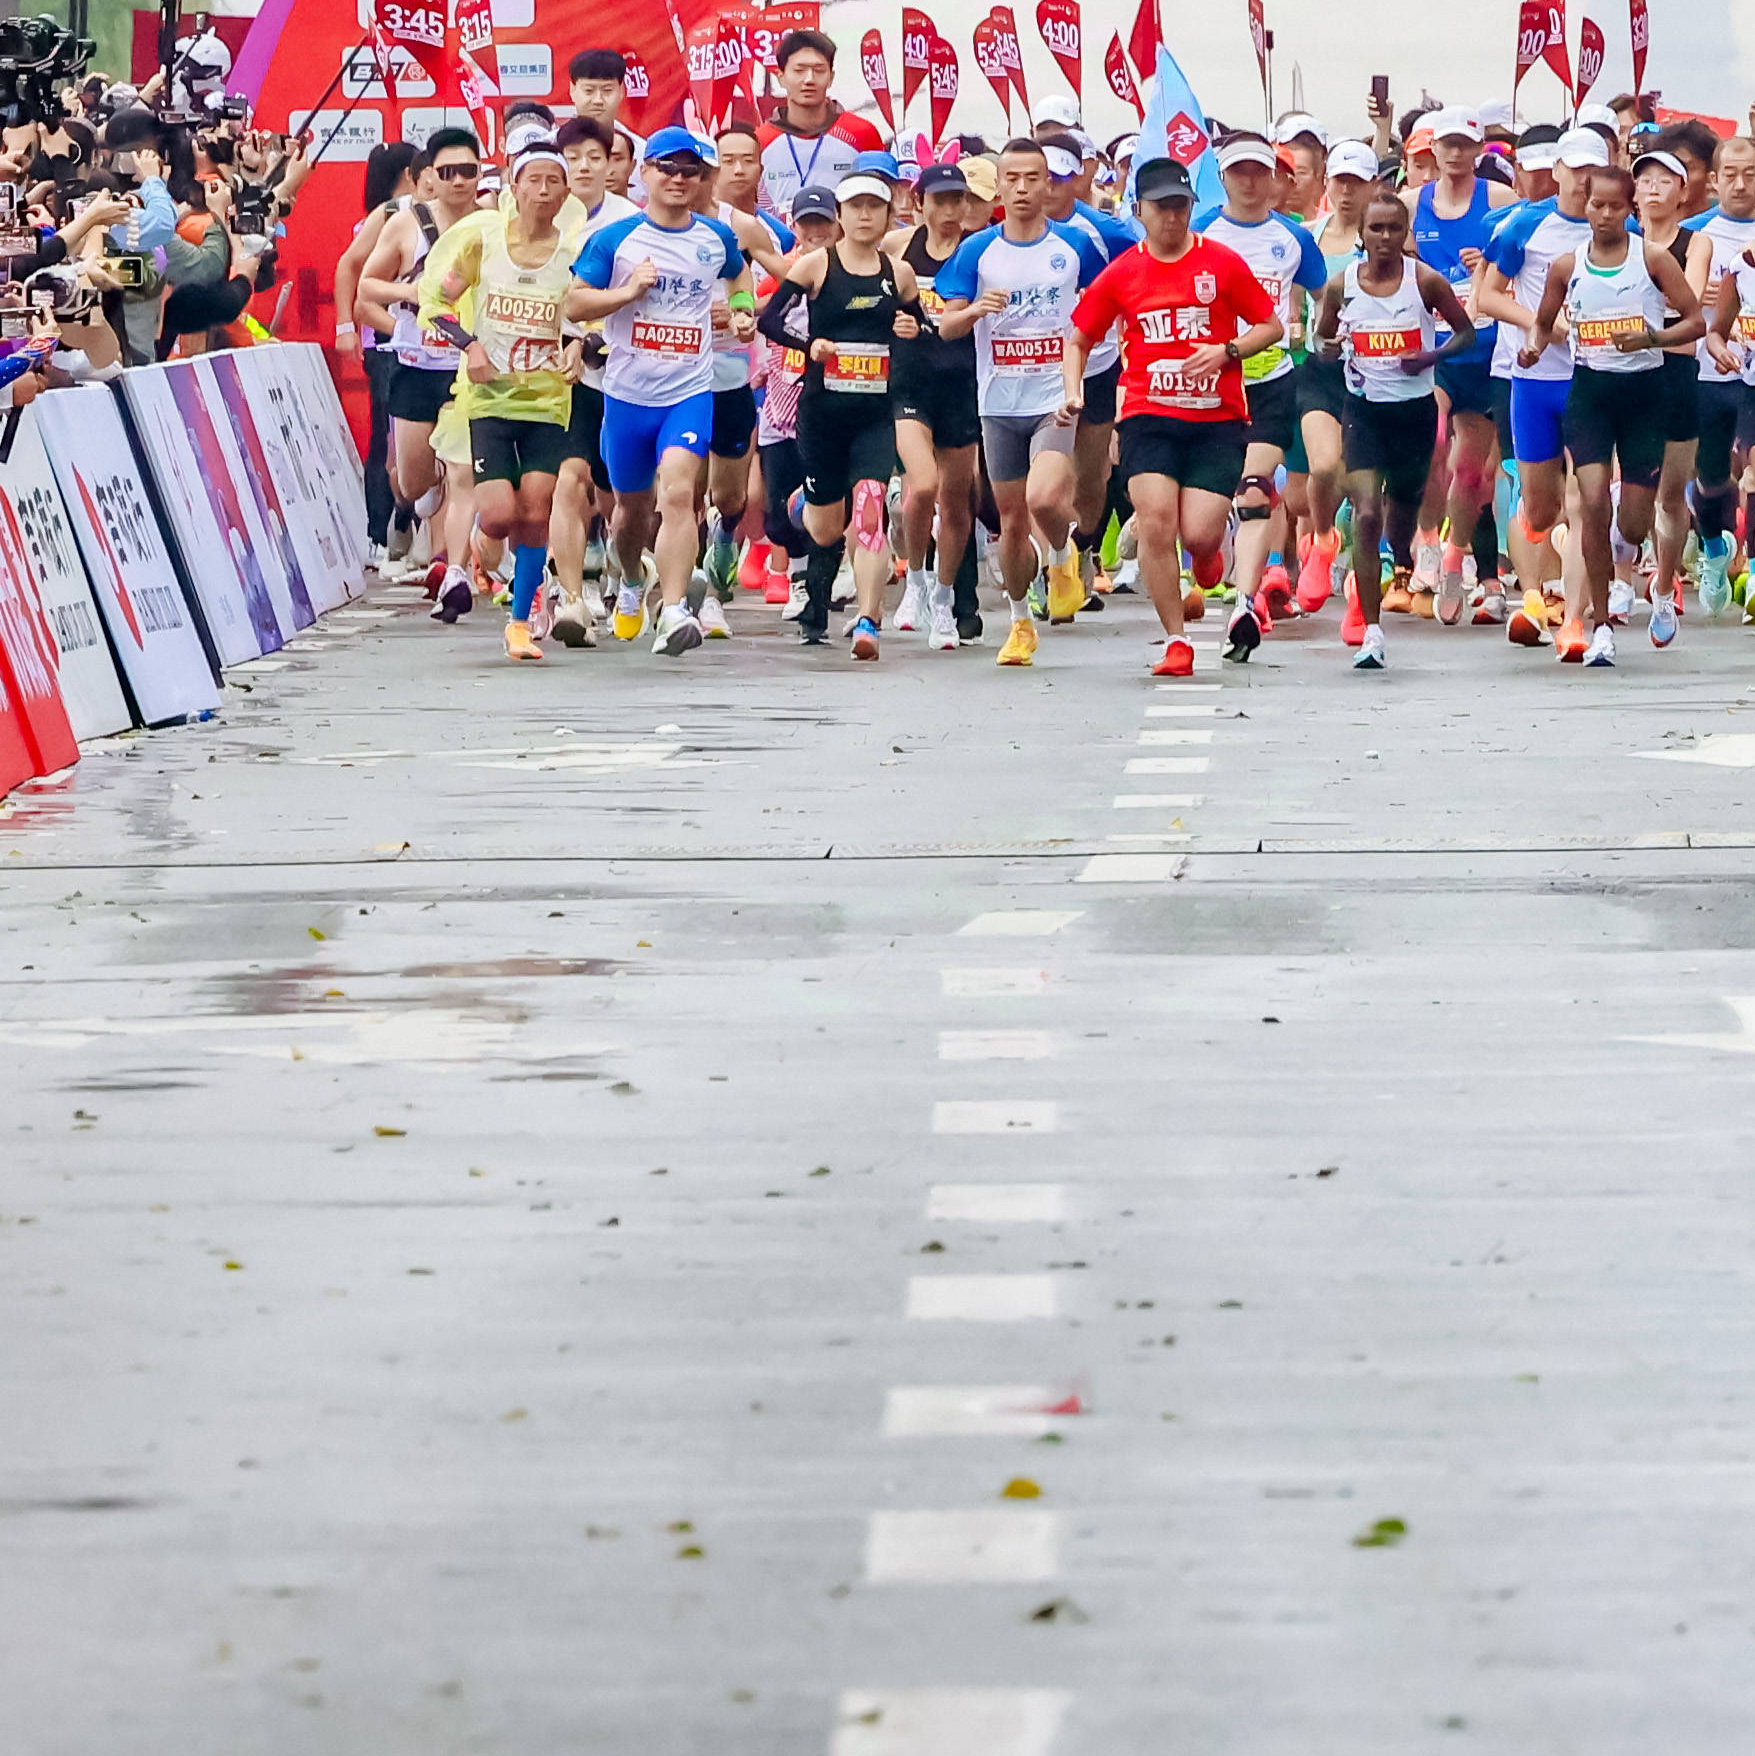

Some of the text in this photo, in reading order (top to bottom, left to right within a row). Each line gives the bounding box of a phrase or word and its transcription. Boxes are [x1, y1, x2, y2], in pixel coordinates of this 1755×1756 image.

[383, 3, 445, 38] 3:45
[458, 10, 492, 44] 3:15
[1042, 17, 1080, 49] 4:00
[714, 38, 742, 68] :00
[932, 65, 959, 90] 5:45
[488, 296, 557, 324] A00520
[1137, 306, 1211, 344] 亚泰
[1367, 332, 1406, 351] KIYA
